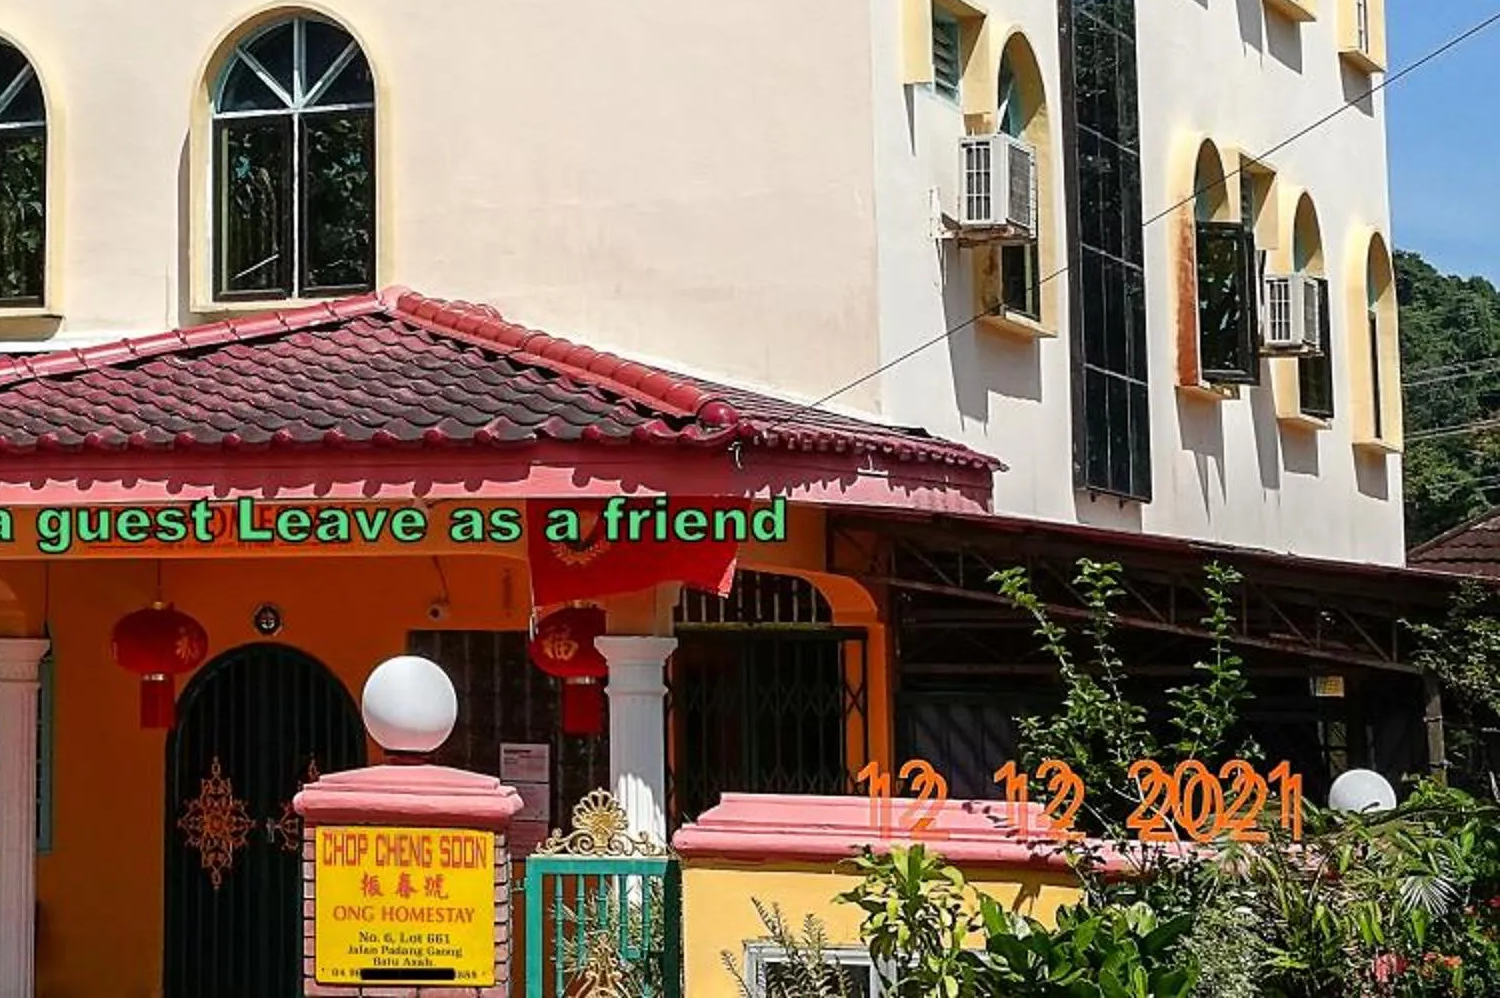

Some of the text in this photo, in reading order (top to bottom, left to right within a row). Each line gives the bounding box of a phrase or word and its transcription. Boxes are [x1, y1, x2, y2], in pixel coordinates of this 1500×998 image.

[322, 831, 487, 869] CHOP CHENG SOON
[333, 905, 475, 923] ONG HOMESTAY
[358, 931, 380, 944] No.
[399, 932, 423, 944] Lot
[348, 945, 379, 955] Jalan
[381, 945, 424, 958] Padang
[373, 957, 399, 967] Batu
